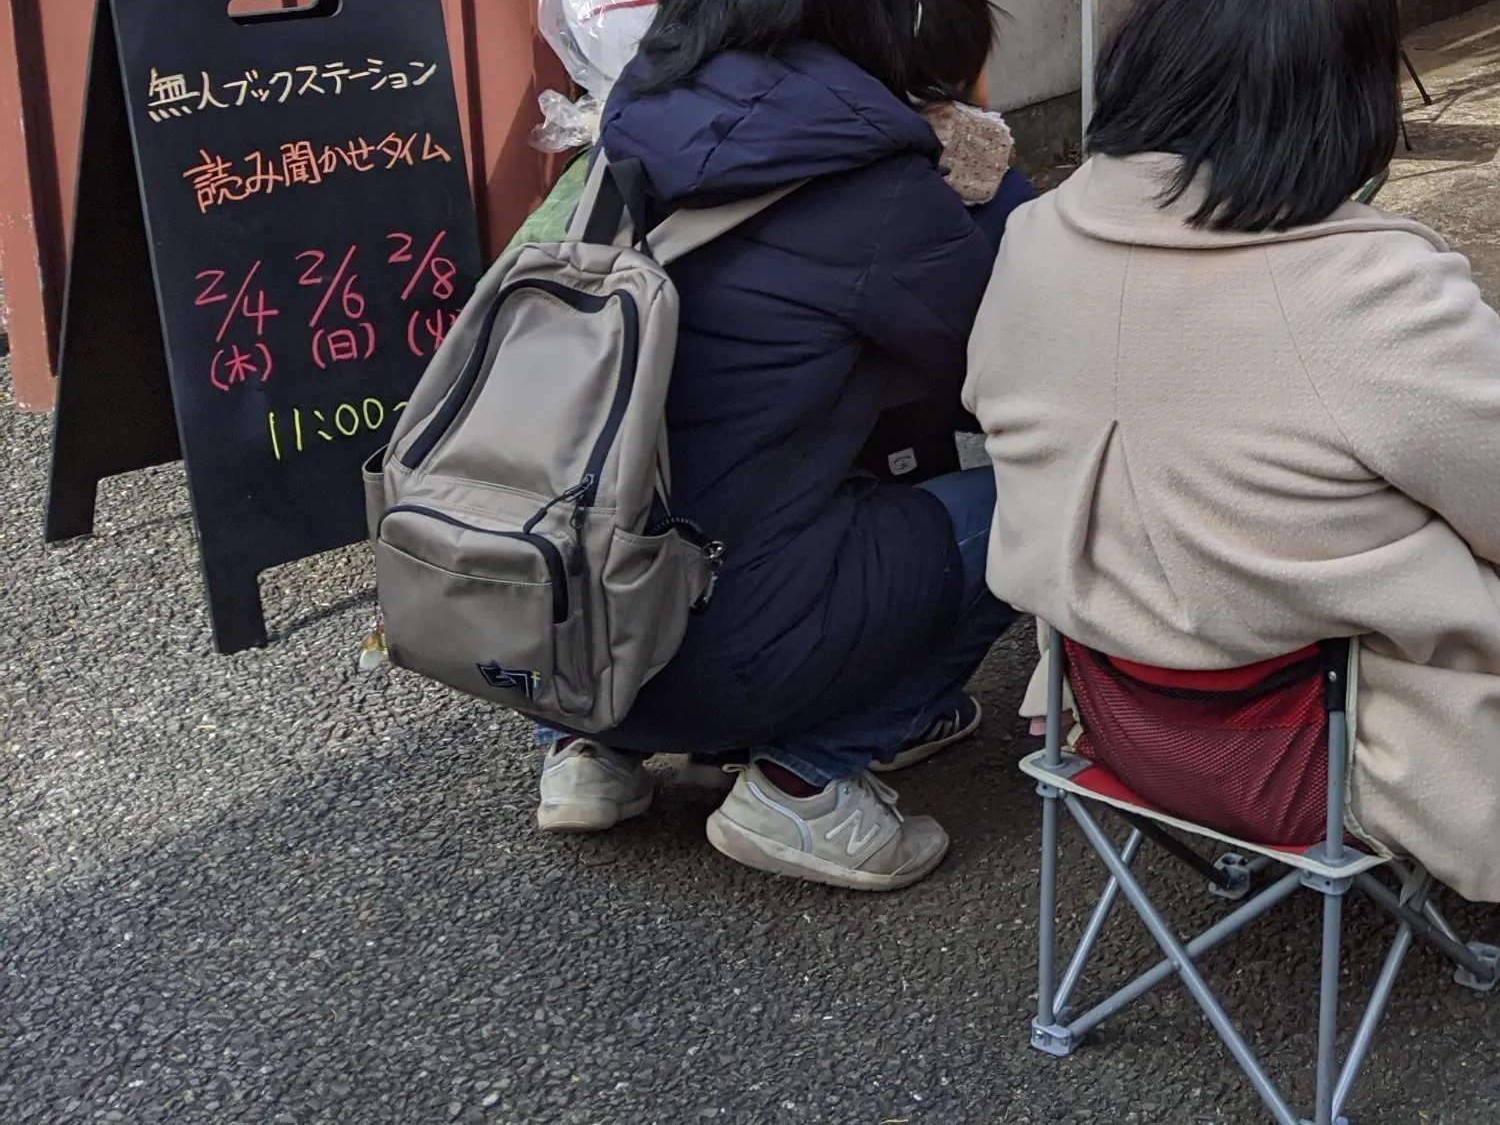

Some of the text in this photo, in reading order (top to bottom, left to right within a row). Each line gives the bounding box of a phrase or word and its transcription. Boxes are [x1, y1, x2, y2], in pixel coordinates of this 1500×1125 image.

[146, 60, 437, 121] 無人ブックステーション
[184, 131, 452, 213] 読み聞かせタイム
[194, 230, 457, 343] 2/4 2/6 2/8
[210, 342, 273, 391] (木)
[312, 322, 376, 369] (日)
[825, 809, 880, 857] N
